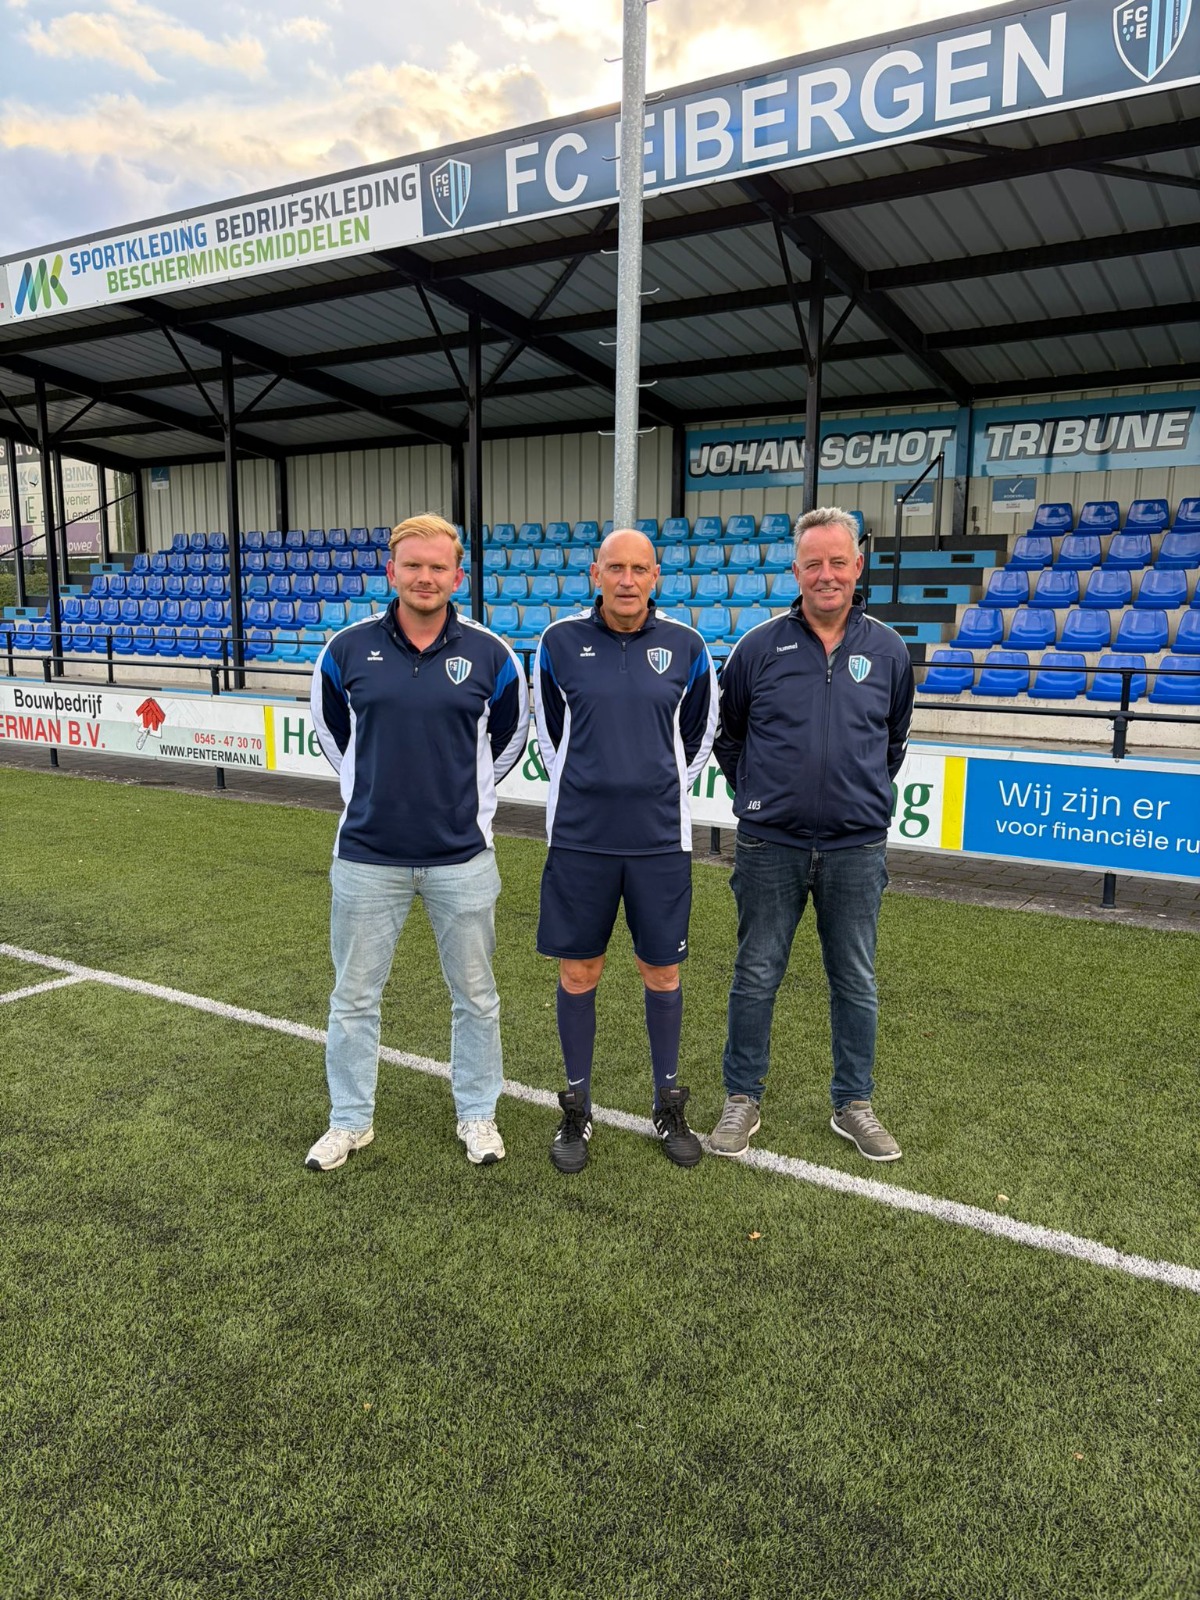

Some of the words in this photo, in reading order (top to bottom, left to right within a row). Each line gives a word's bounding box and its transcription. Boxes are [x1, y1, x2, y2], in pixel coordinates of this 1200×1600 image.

[505, 133, 588, 213] FC
[70, 223, 207, 275] SPORTKLEDING
[216, 172, 417, 243] BEDRIJFSKLEDING
[106, 215, 370, 294] BESCHERMINGSMIDDELEN
[689, 438, 806, 476] JOHAN
[819, 428, 952, 468] SCHOT
[987, 411, 1191, 458] TRIBUNE
[14, 689, 102, 719] Bouwbedrijf
[68, 720, 106, 748] B.V.
[194, 733, 216, 745] 0545
[224, 736, 234, 747] 47
[237, 736, 248, 749] 30
[251, 738, 262, 750] 70
[160, 744, 262, 766] WWW.PENTERMAN.NL
[999, 780, 1051, 816] Wij
[1062, 787, 1121, 821] zijn
[1133, 798, 1170, 820] er
[996, 819, 1047, 837] voor
[1053, 822, 1169, 851] financiële
